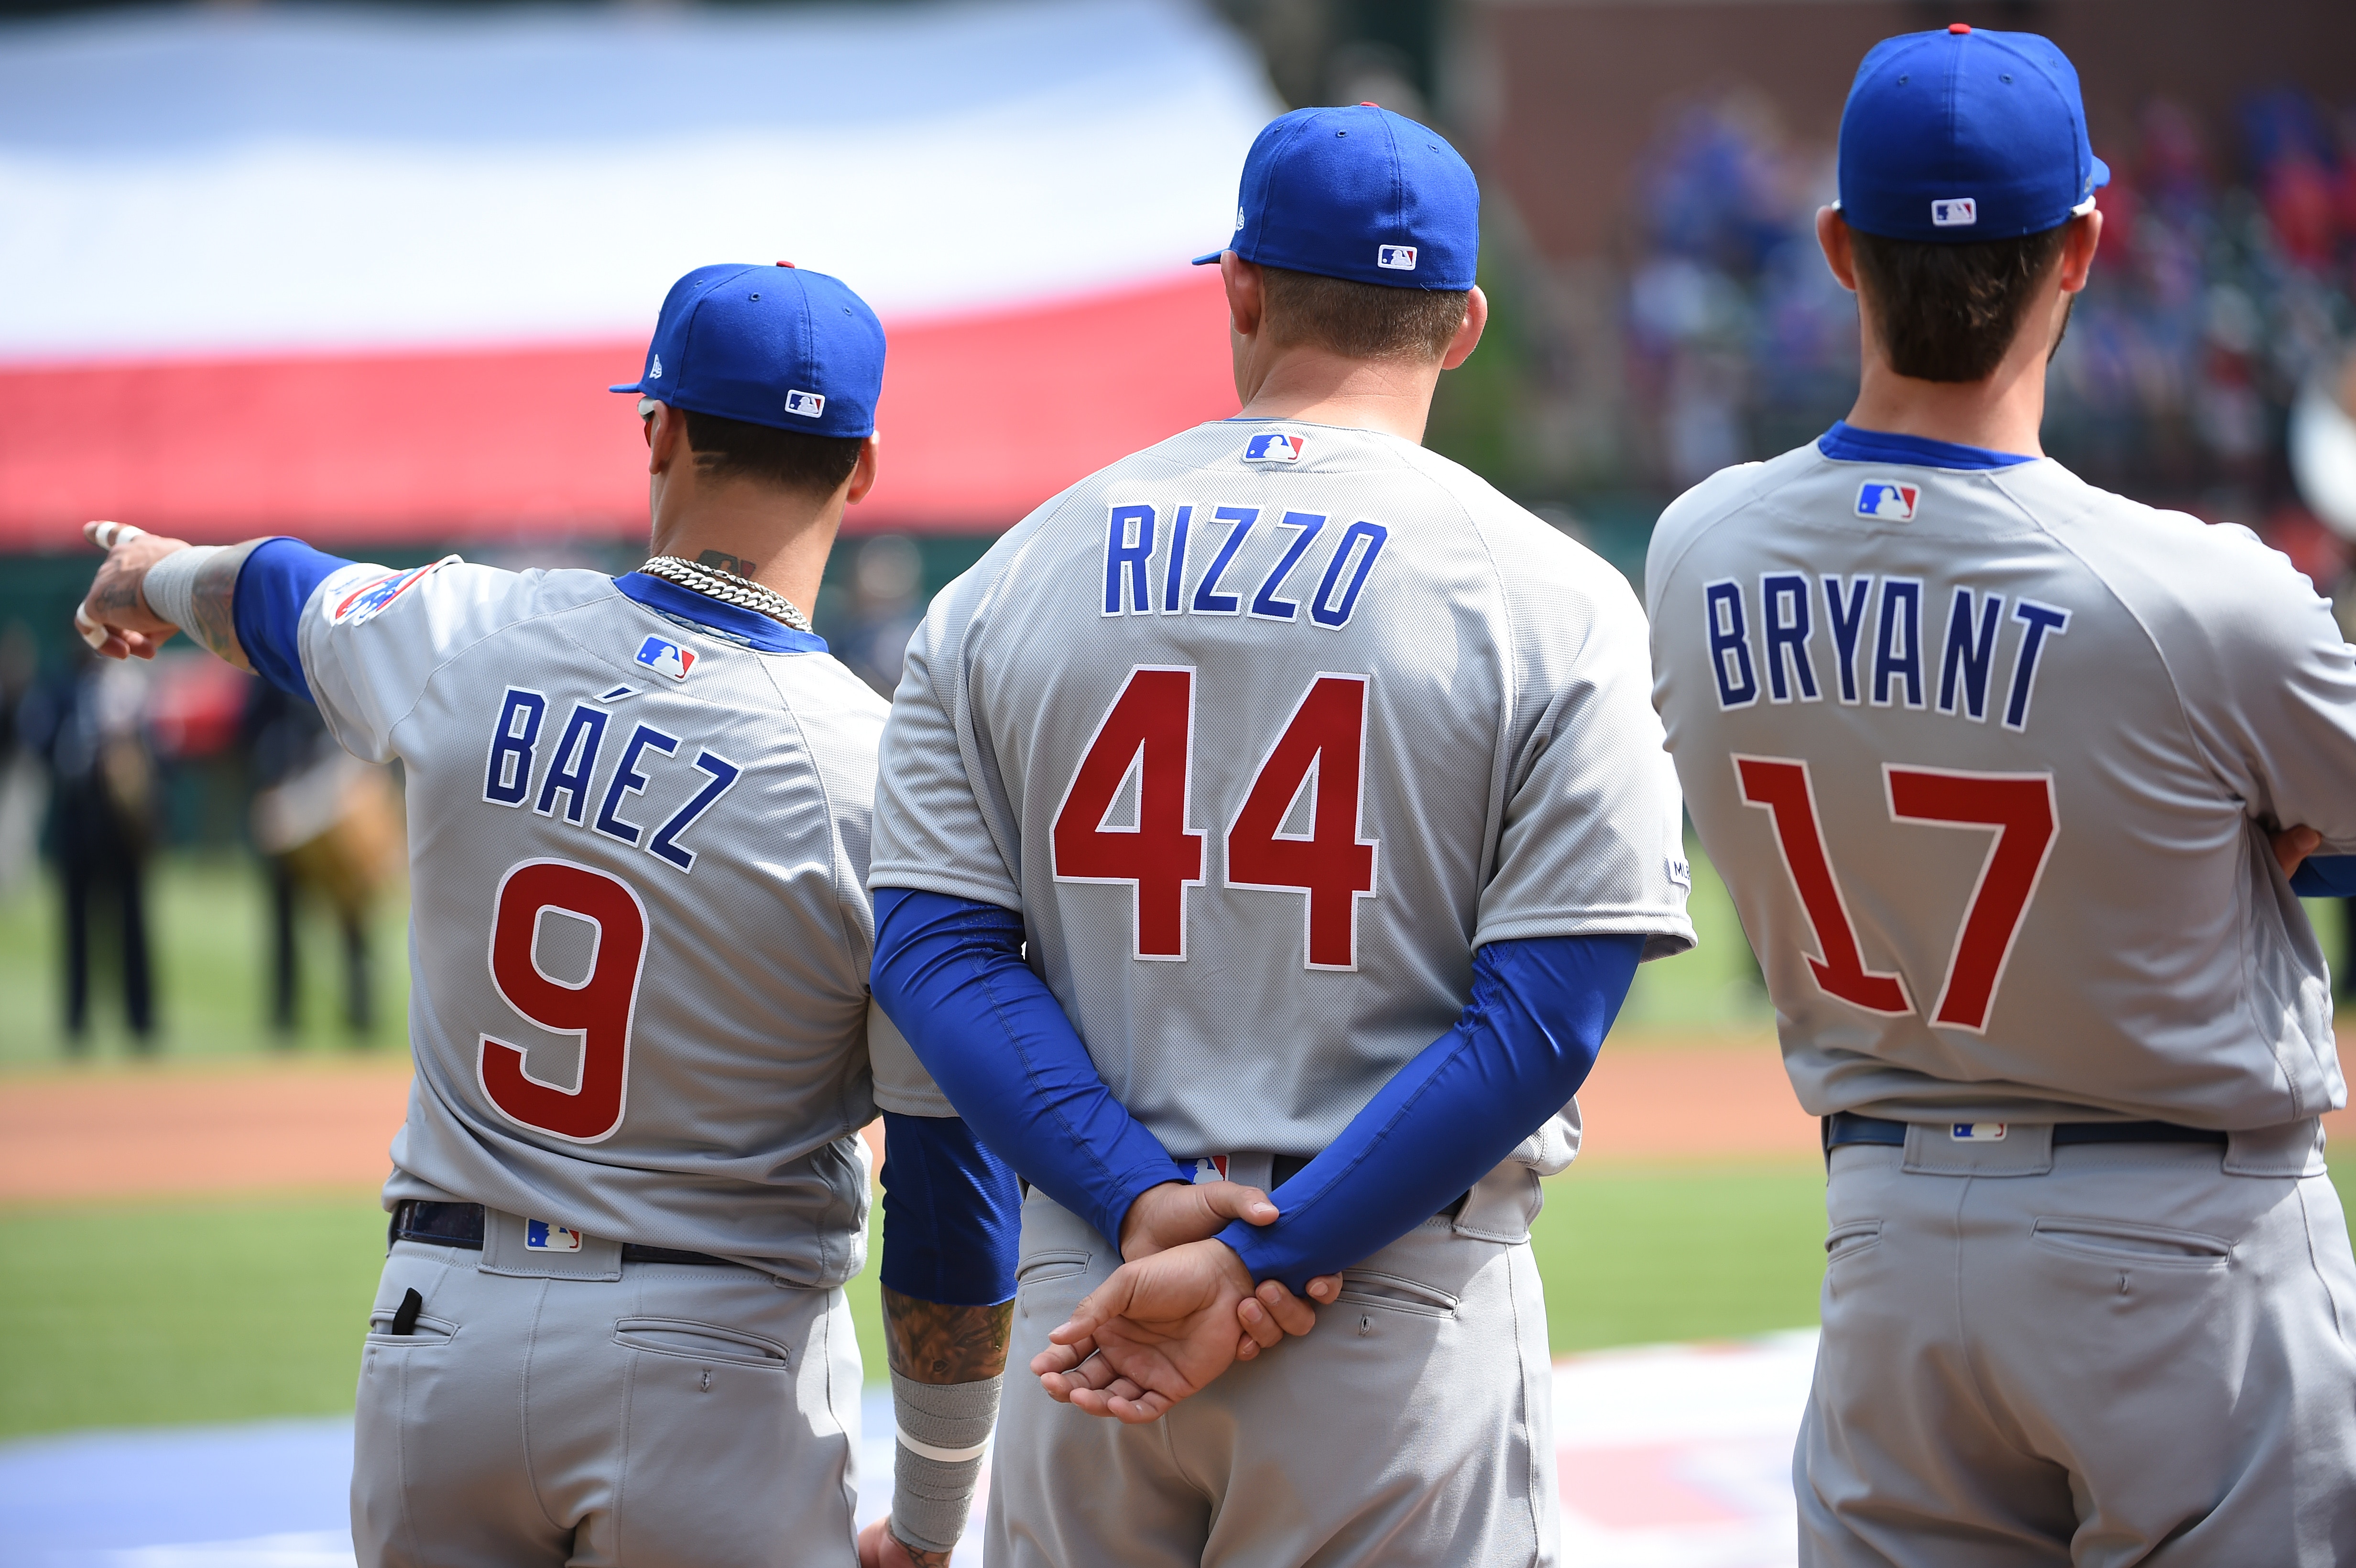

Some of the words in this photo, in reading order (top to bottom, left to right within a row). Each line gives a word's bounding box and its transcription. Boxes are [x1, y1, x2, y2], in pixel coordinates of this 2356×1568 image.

[1101, 504, 1390, 631] RIZZO
[1702, 571, 2073, 733] BRYANT
[482, 683, 744, 874] BÁEZ
[1049, 664, 1379, 972] 44
[1730, 752, 2061, 1035] 17
[477, 857, 650, 1144] 9
